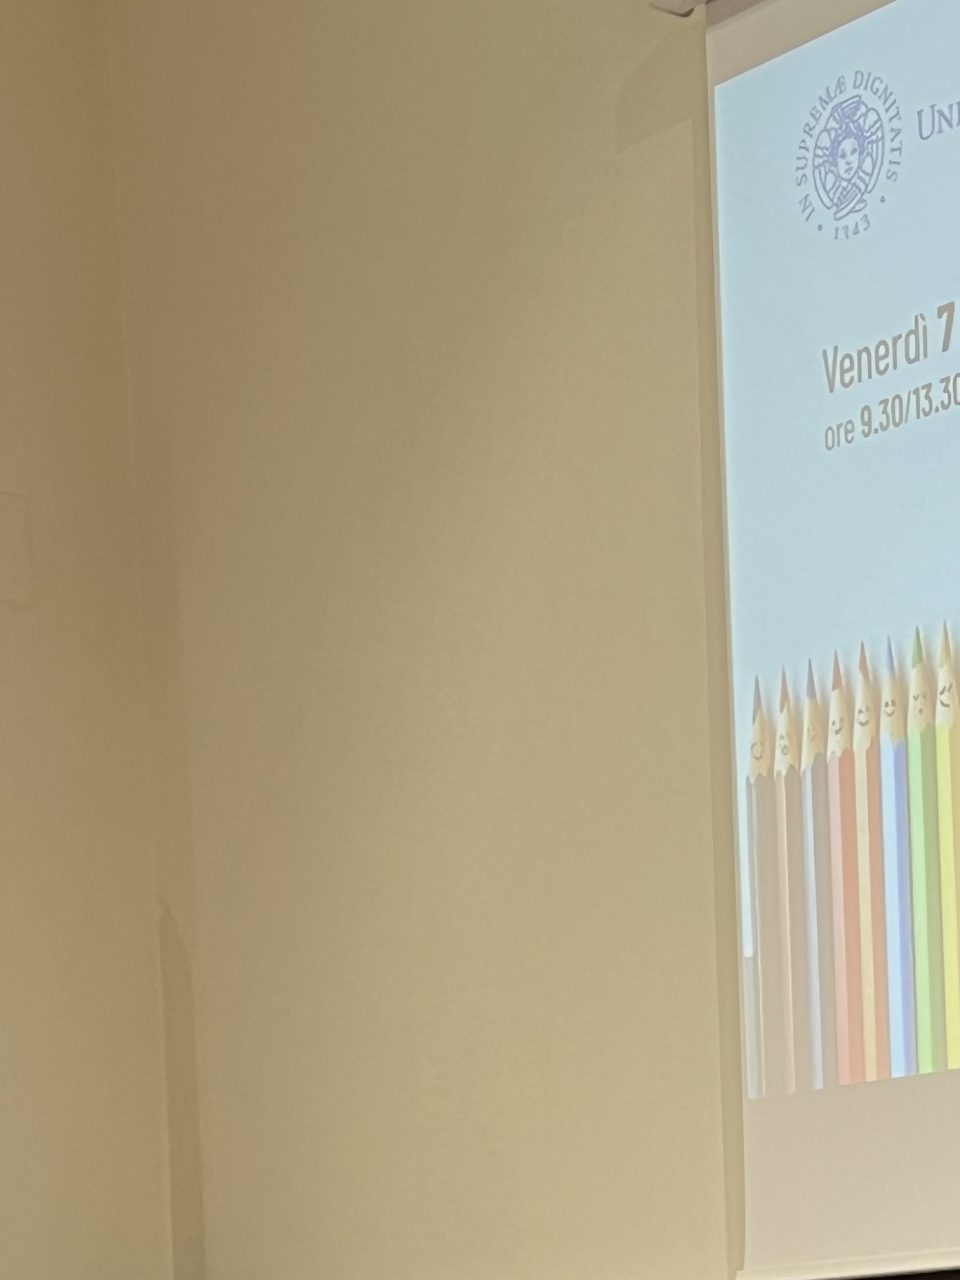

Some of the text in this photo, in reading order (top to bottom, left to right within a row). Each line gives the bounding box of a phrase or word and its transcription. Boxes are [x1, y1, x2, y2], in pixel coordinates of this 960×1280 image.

[822, 313, 928, 393] Venerdì
[937, 300, 955, 352] 7
[824, 414, 855, 451] ore
